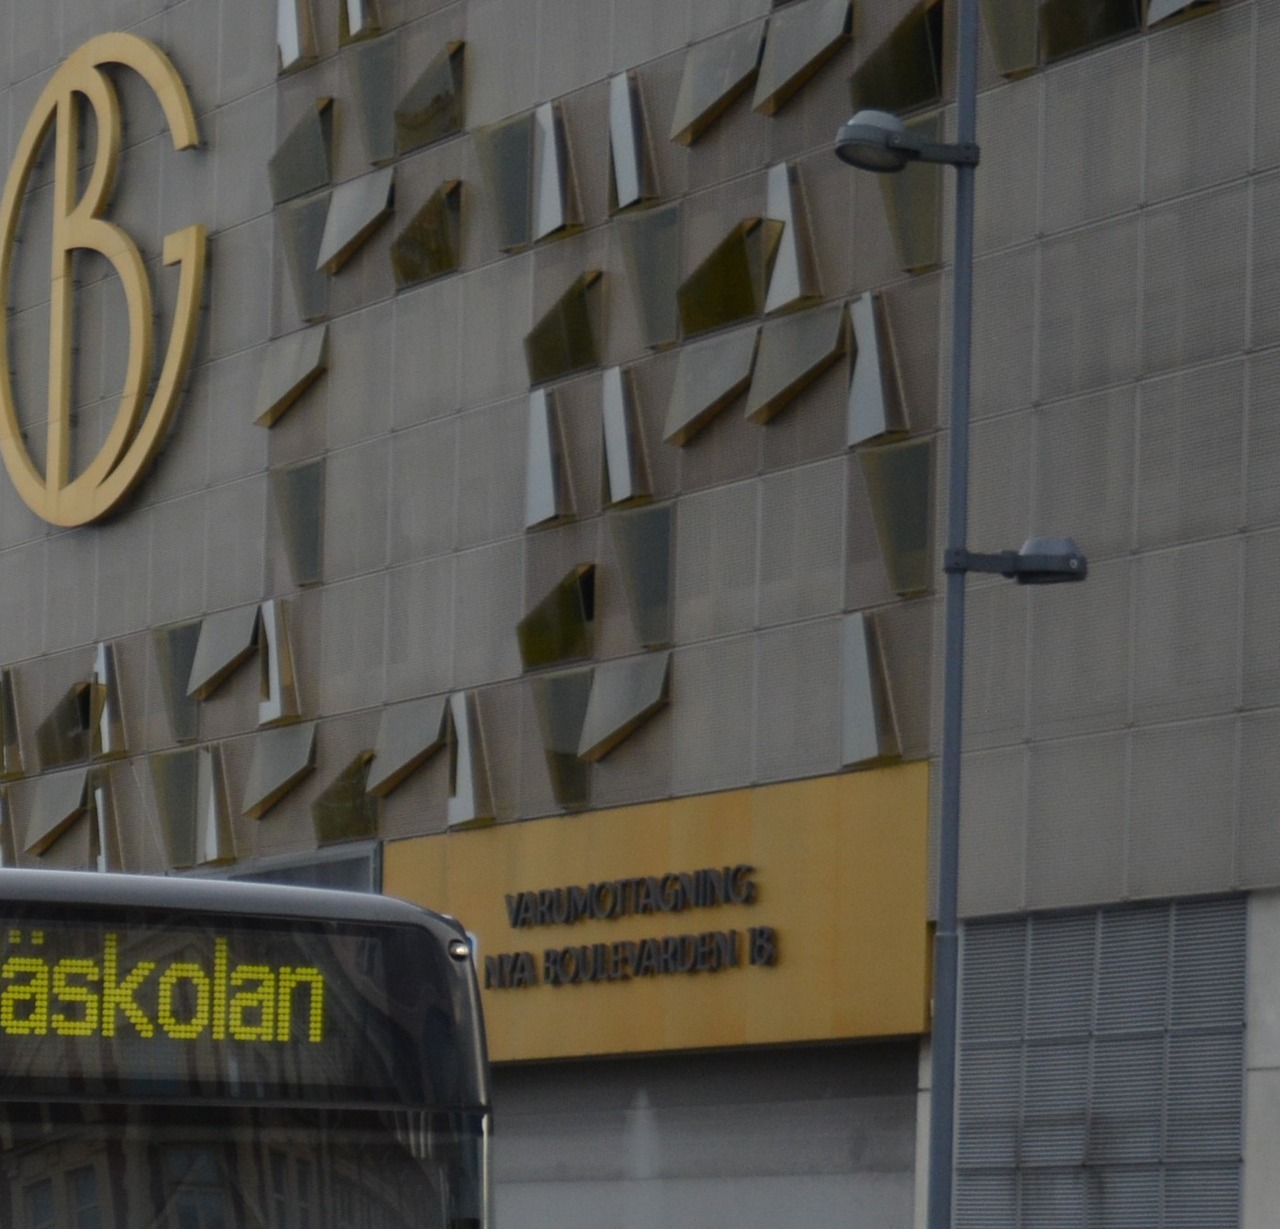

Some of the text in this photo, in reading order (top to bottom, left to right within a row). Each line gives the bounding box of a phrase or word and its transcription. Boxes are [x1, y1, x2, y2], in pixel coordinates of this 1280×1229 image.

[505, 864, 758, 929] VARUMOTTAGNING
[484, 952, 538, 990] NYA
[544, 929, 739, 987] BOULEVARDEN
